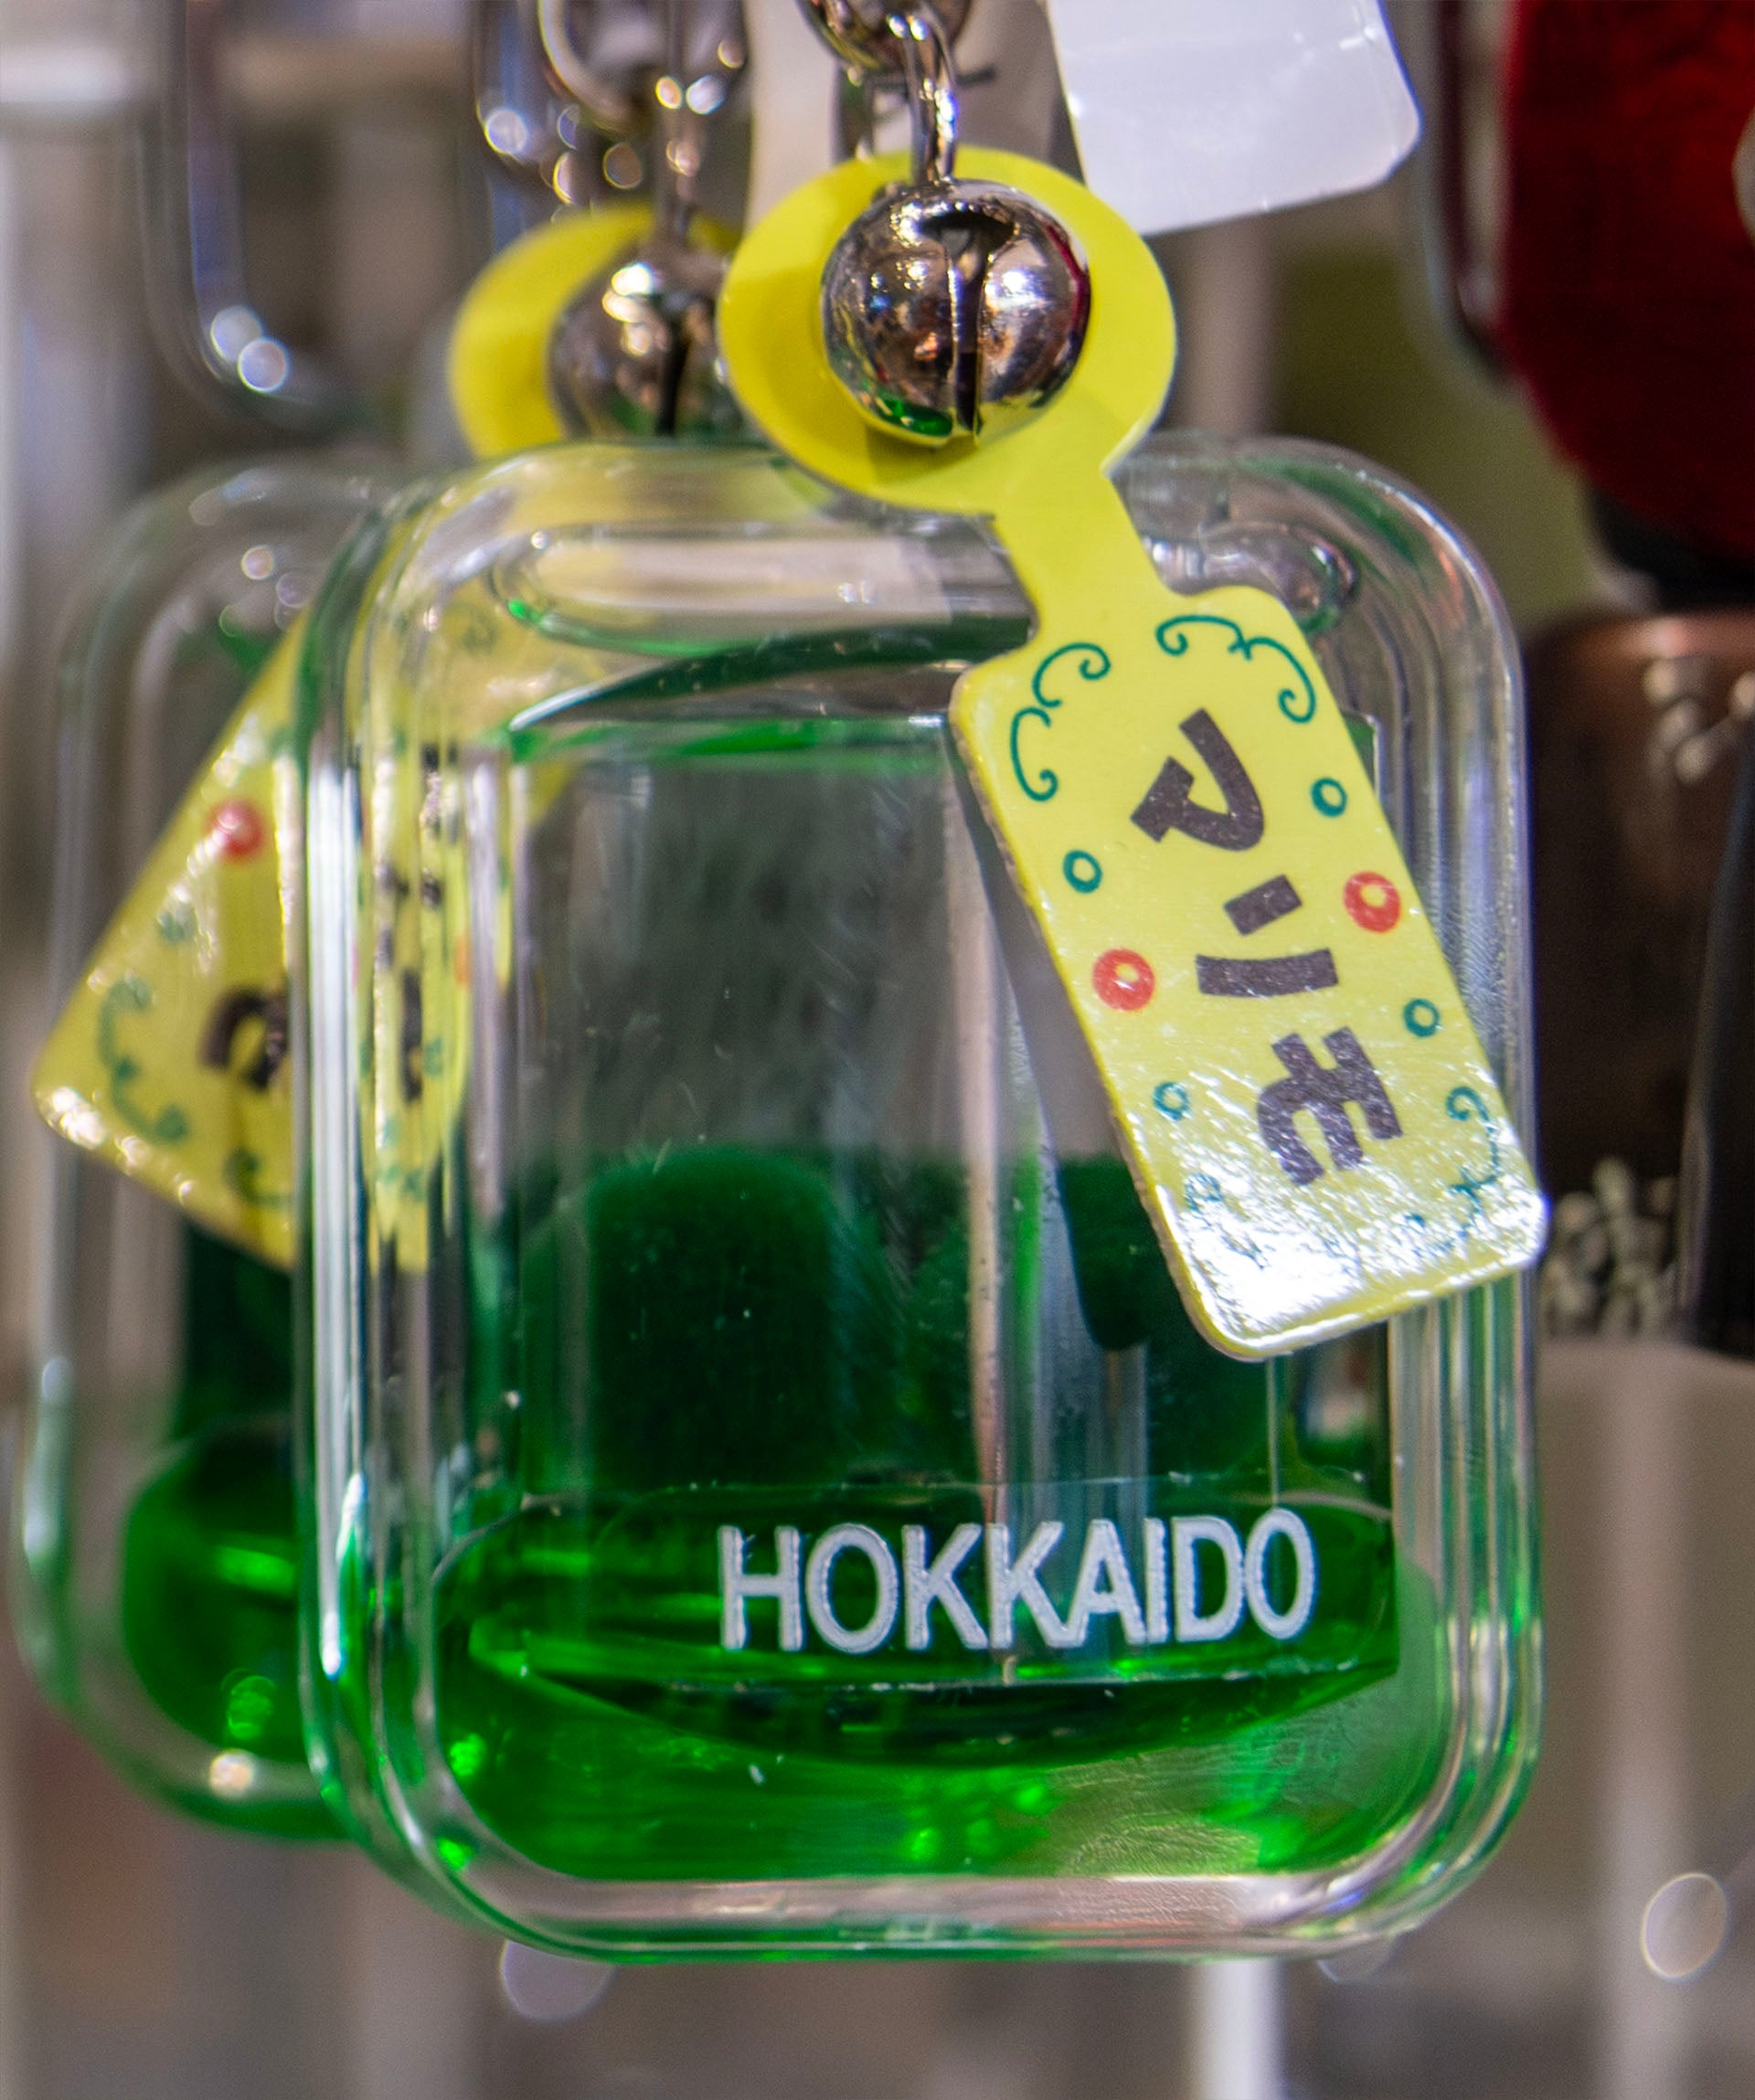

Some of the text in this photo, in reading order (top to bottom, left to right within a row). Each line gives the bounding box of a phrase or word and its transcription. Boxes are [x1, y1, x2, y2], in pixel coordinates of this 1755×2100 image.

[1130, 708, 1403, 1186] マリモ
[718, 1509, 1316, 1652] HOKKAIDO
